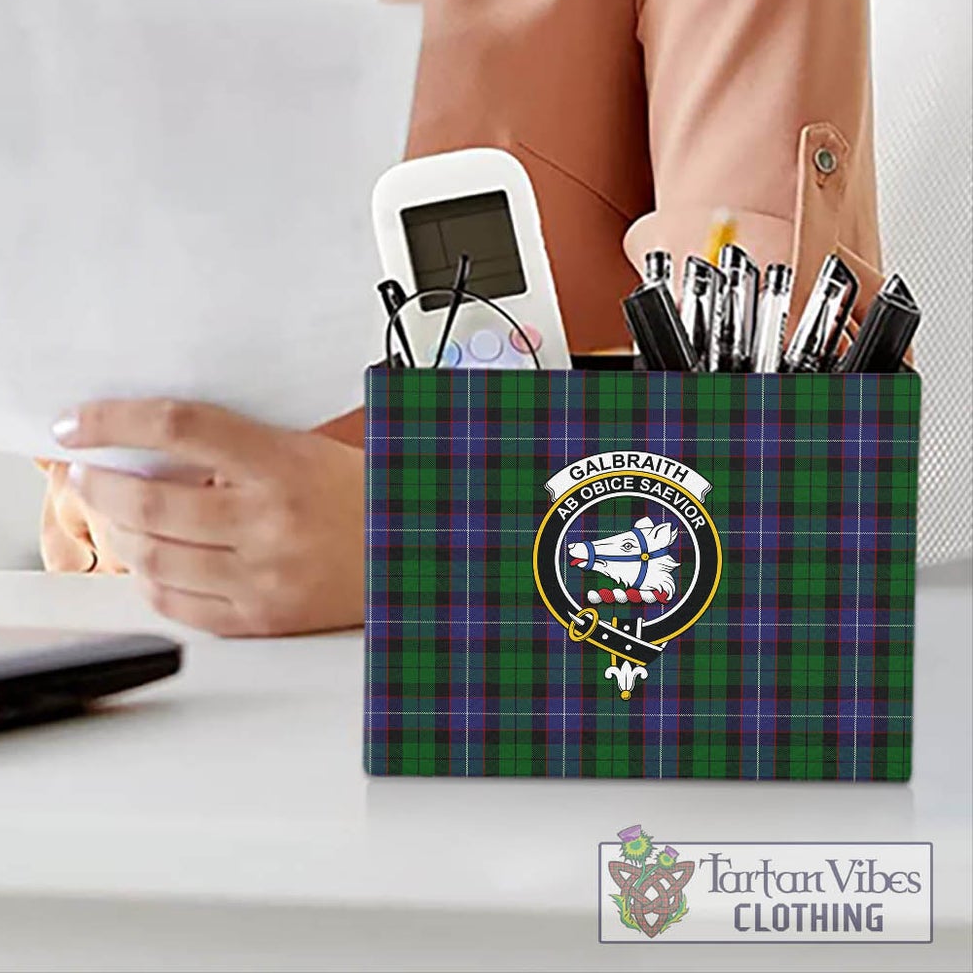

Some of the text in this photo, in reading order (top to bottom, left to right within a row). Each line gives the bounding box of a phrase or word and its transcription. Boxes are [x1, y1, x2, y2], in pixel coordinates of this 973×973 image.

[570, 454, 689, 482] GALBRAITH
[557, 478, 706, 530] AB OBICE SAEVIOR
